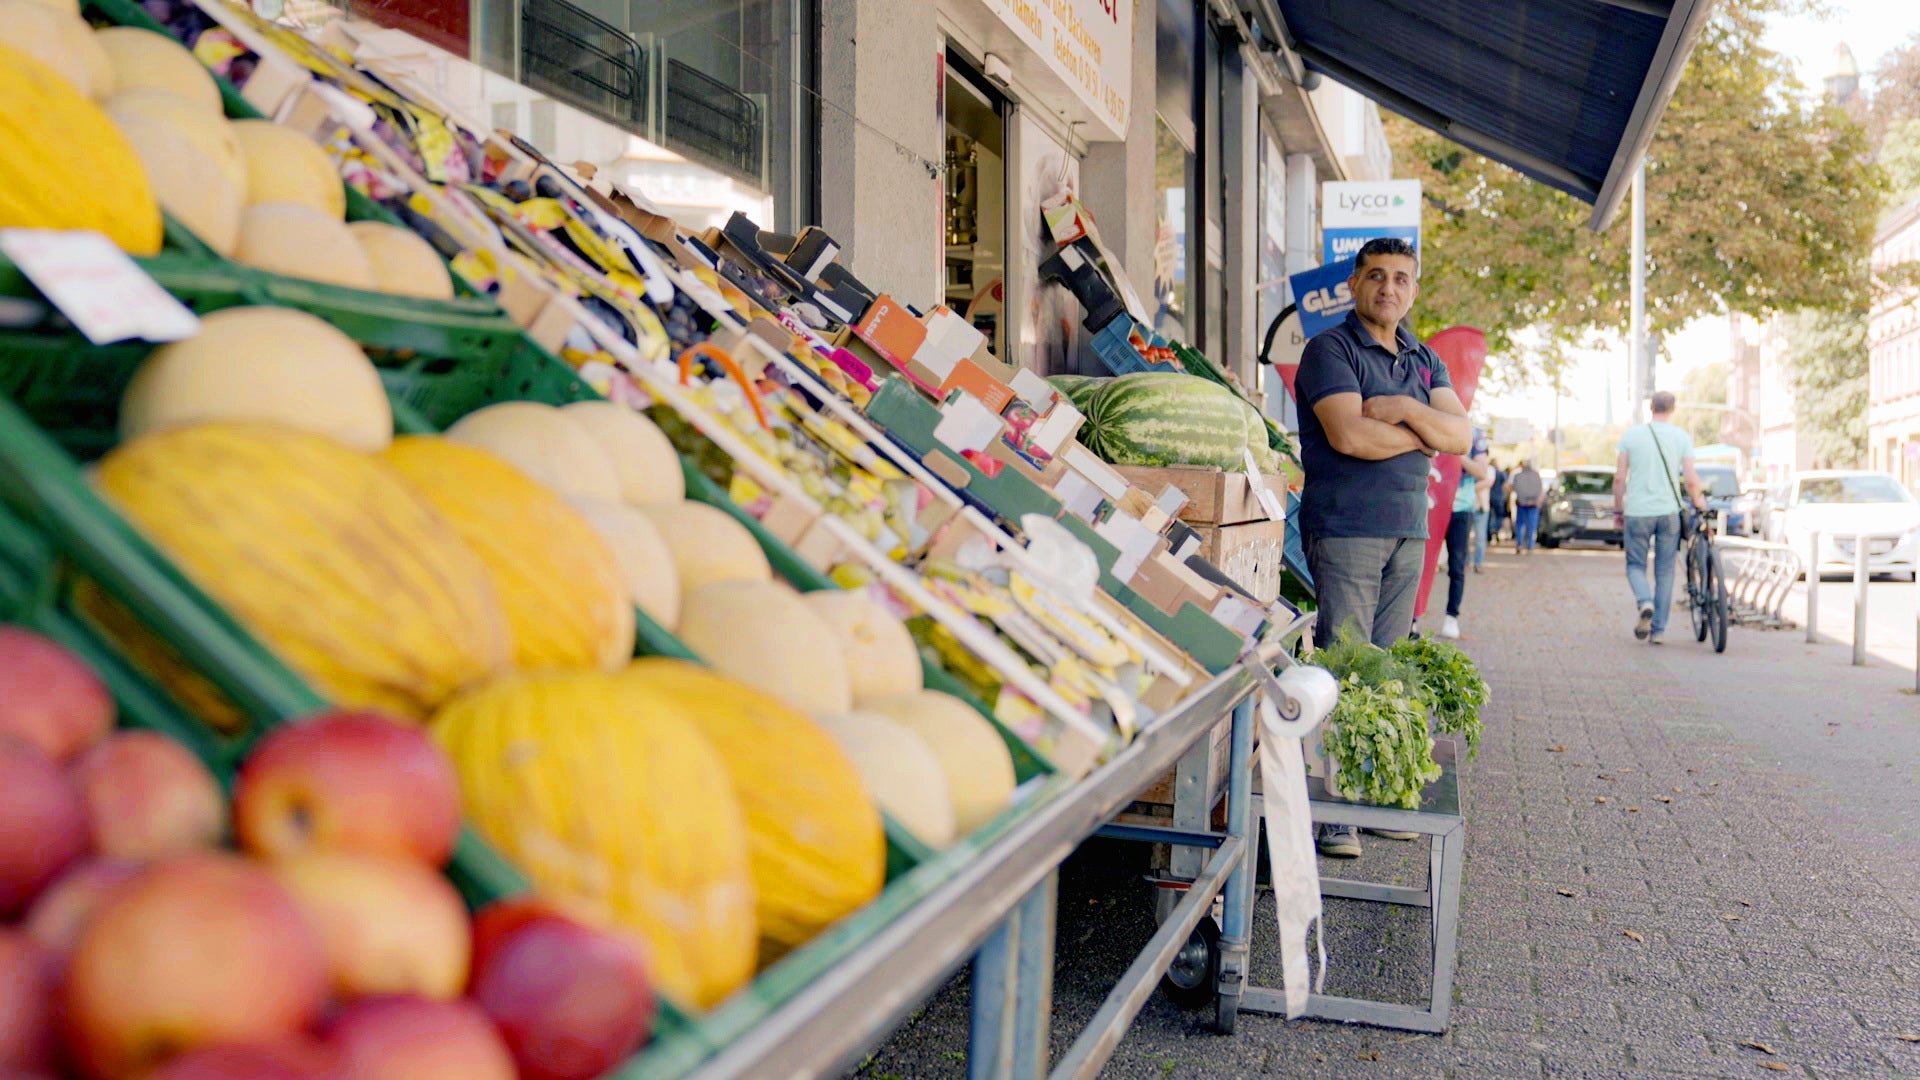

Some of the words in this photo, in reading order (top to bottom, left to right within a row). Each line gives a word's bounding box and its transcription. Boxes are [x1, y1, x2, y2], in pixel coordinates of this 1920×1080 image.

[1053, 26, 1077, 77] Telefon
[1339, 192, 1389, 211] Lyca
[1302, 281, 1352, 313] GLS
